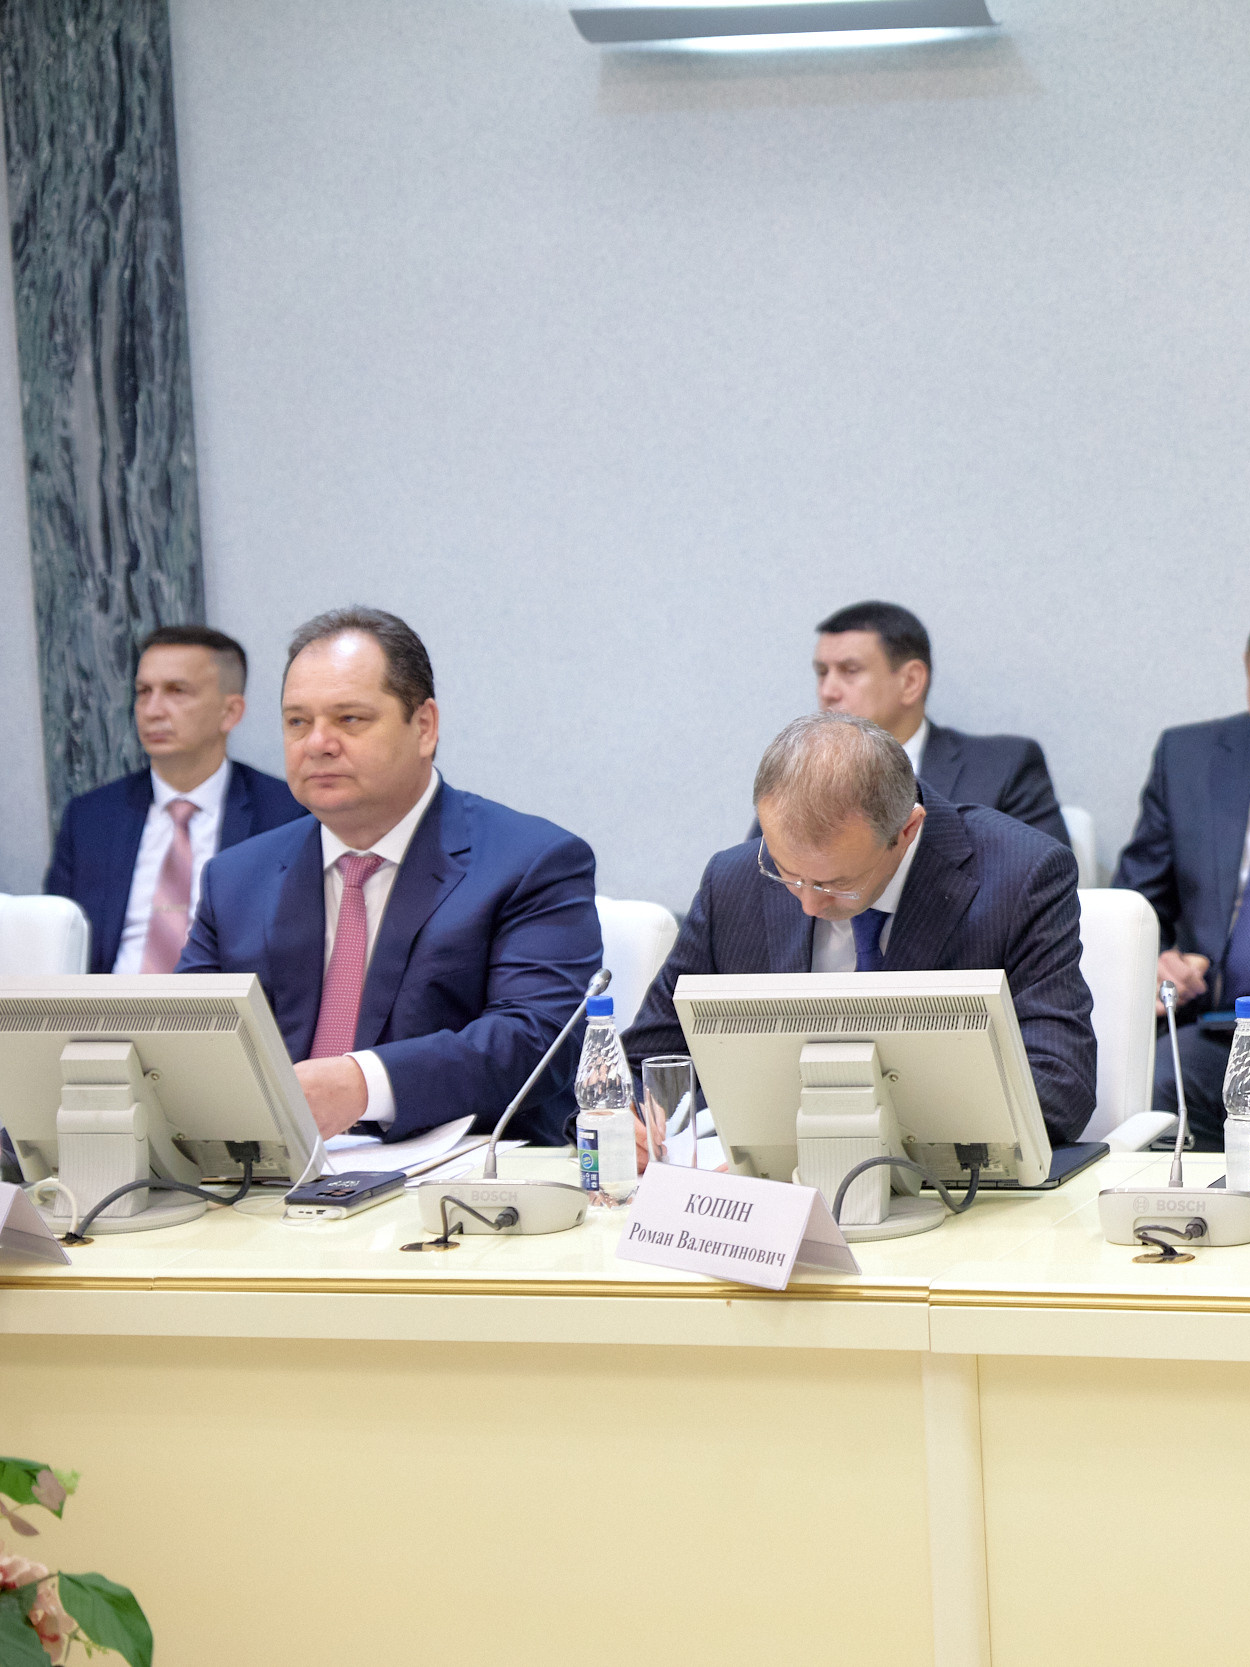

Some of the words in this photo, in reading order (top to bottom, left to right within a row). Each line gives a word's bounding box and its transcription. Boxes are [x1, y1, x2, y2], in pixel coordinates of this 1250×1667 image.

[471, 1190, 518, 1202] BOSCH
[1156, 1200, 1206, 1213] BOSCH
[683, 1193, 754, 1223] КОПИН
[628, 1222, 674, 1247] Роман
[676, 1230, 786, 1267] Валентинович
